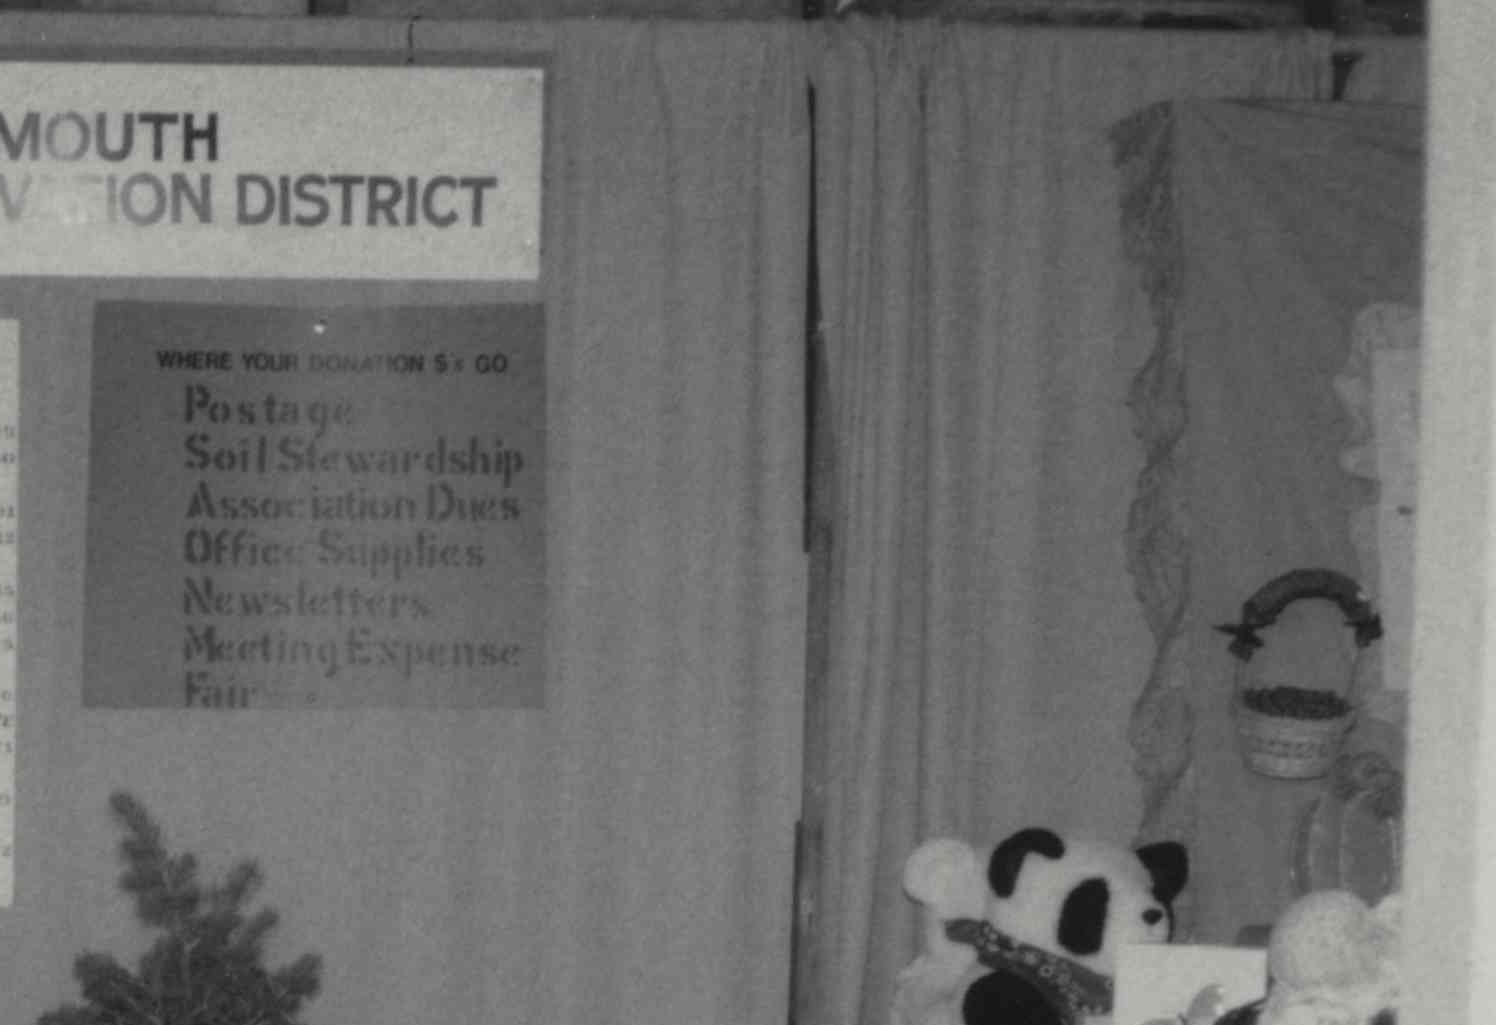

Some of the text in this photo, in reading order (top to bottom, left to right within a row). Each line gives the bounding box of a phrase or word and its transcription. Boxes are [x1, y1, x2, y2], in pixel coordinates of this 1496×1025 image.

[235, 175, 497, 228] DISTRICT
[156, 351, 233, 371] WHERE
[241, 353, 298, 372] YOUR
[308, 354, 425, 373] DONATION
[474, 355, 509, 375] GO
[184, 384, 355, 438] Postage
[184, 434, 525, 488] Soil Stewardship
[184, 482, 522, 521] Association Dues
[316, 528, 486, 581] Supplies
[183, 577, 432, 617] Newsletters
[183, 625, 521, 678] Meeting Expense
[184, 671, 258, 707] Fair
